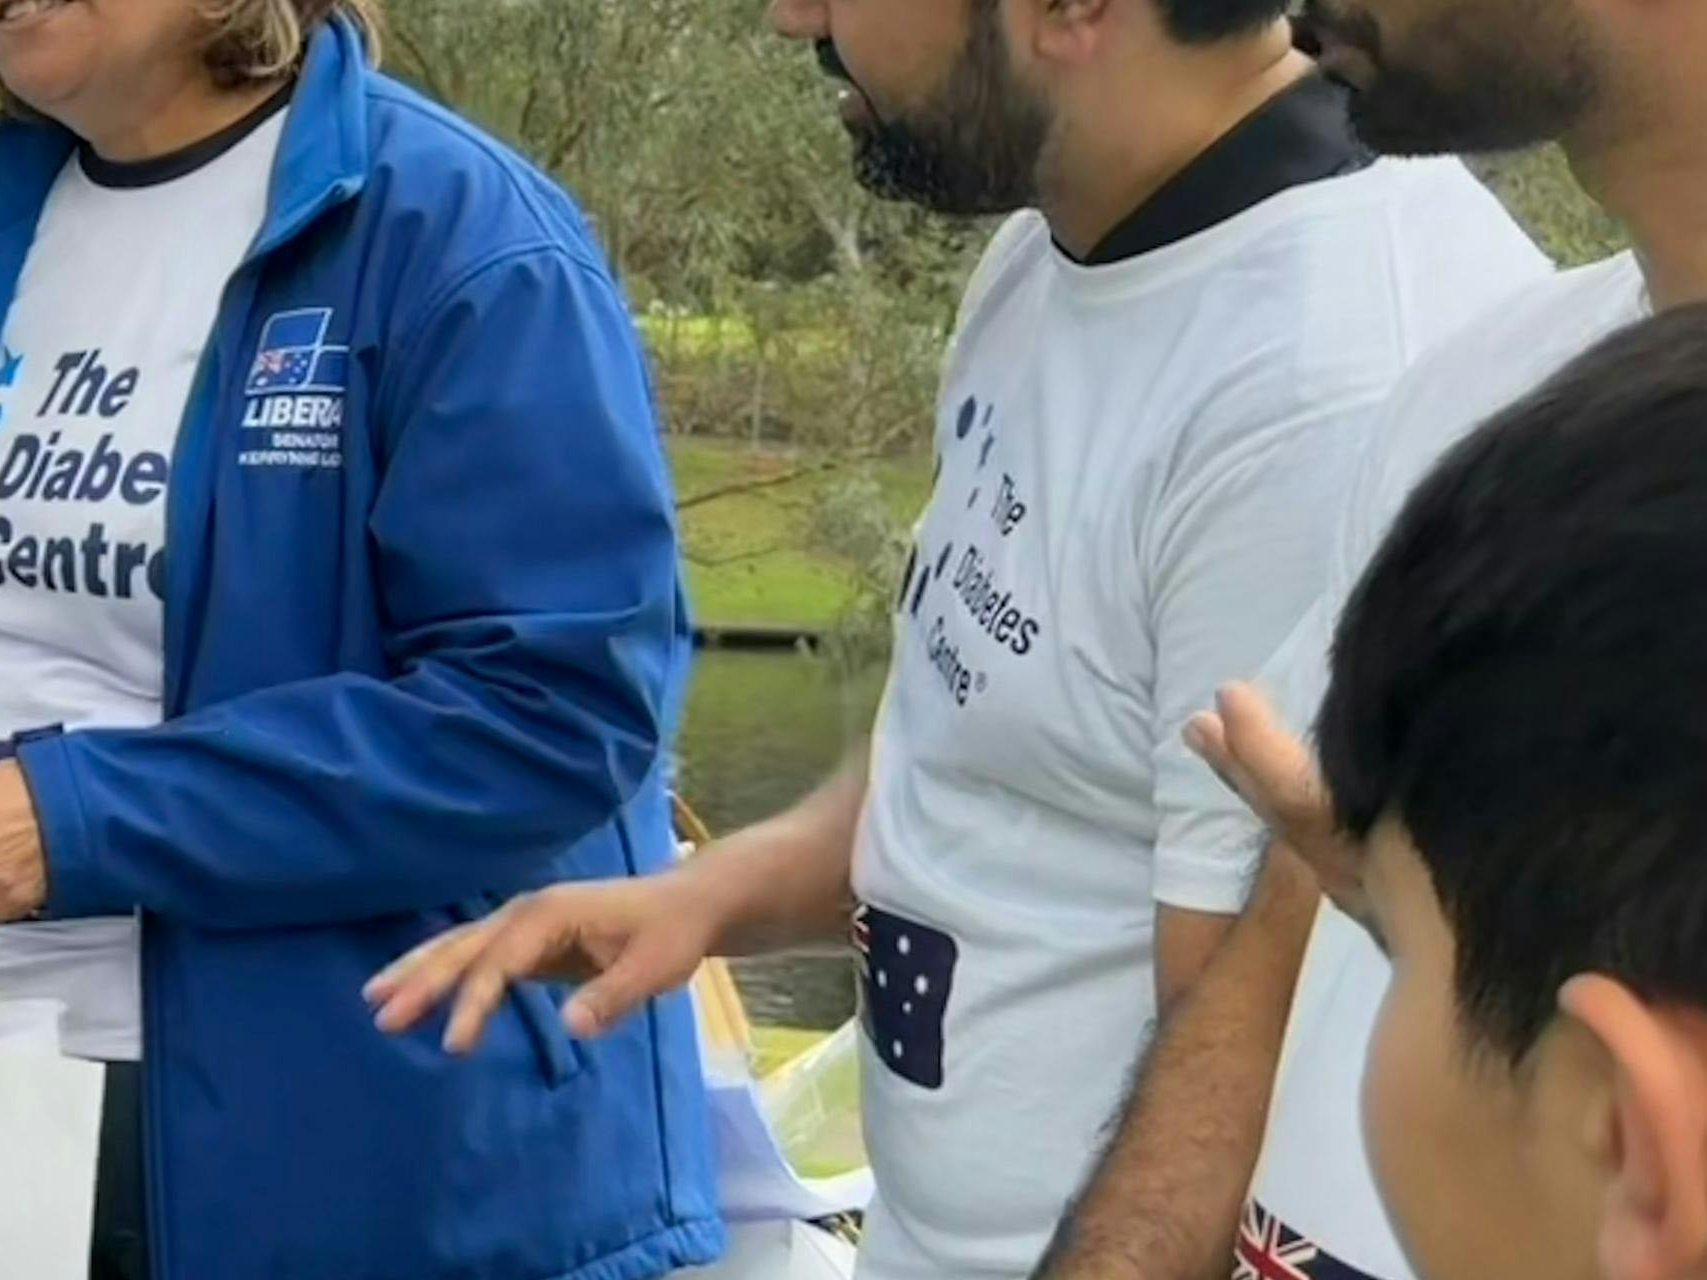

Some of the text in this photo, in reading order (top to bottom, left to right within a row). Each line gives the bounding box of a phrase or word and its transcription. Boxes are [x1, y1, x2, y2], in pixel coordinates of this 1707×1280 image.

[35, 348, 140, 418] The
[241, 395, 345, 428] LIBERA
[952, 545, 1041, 656] Diabetes
